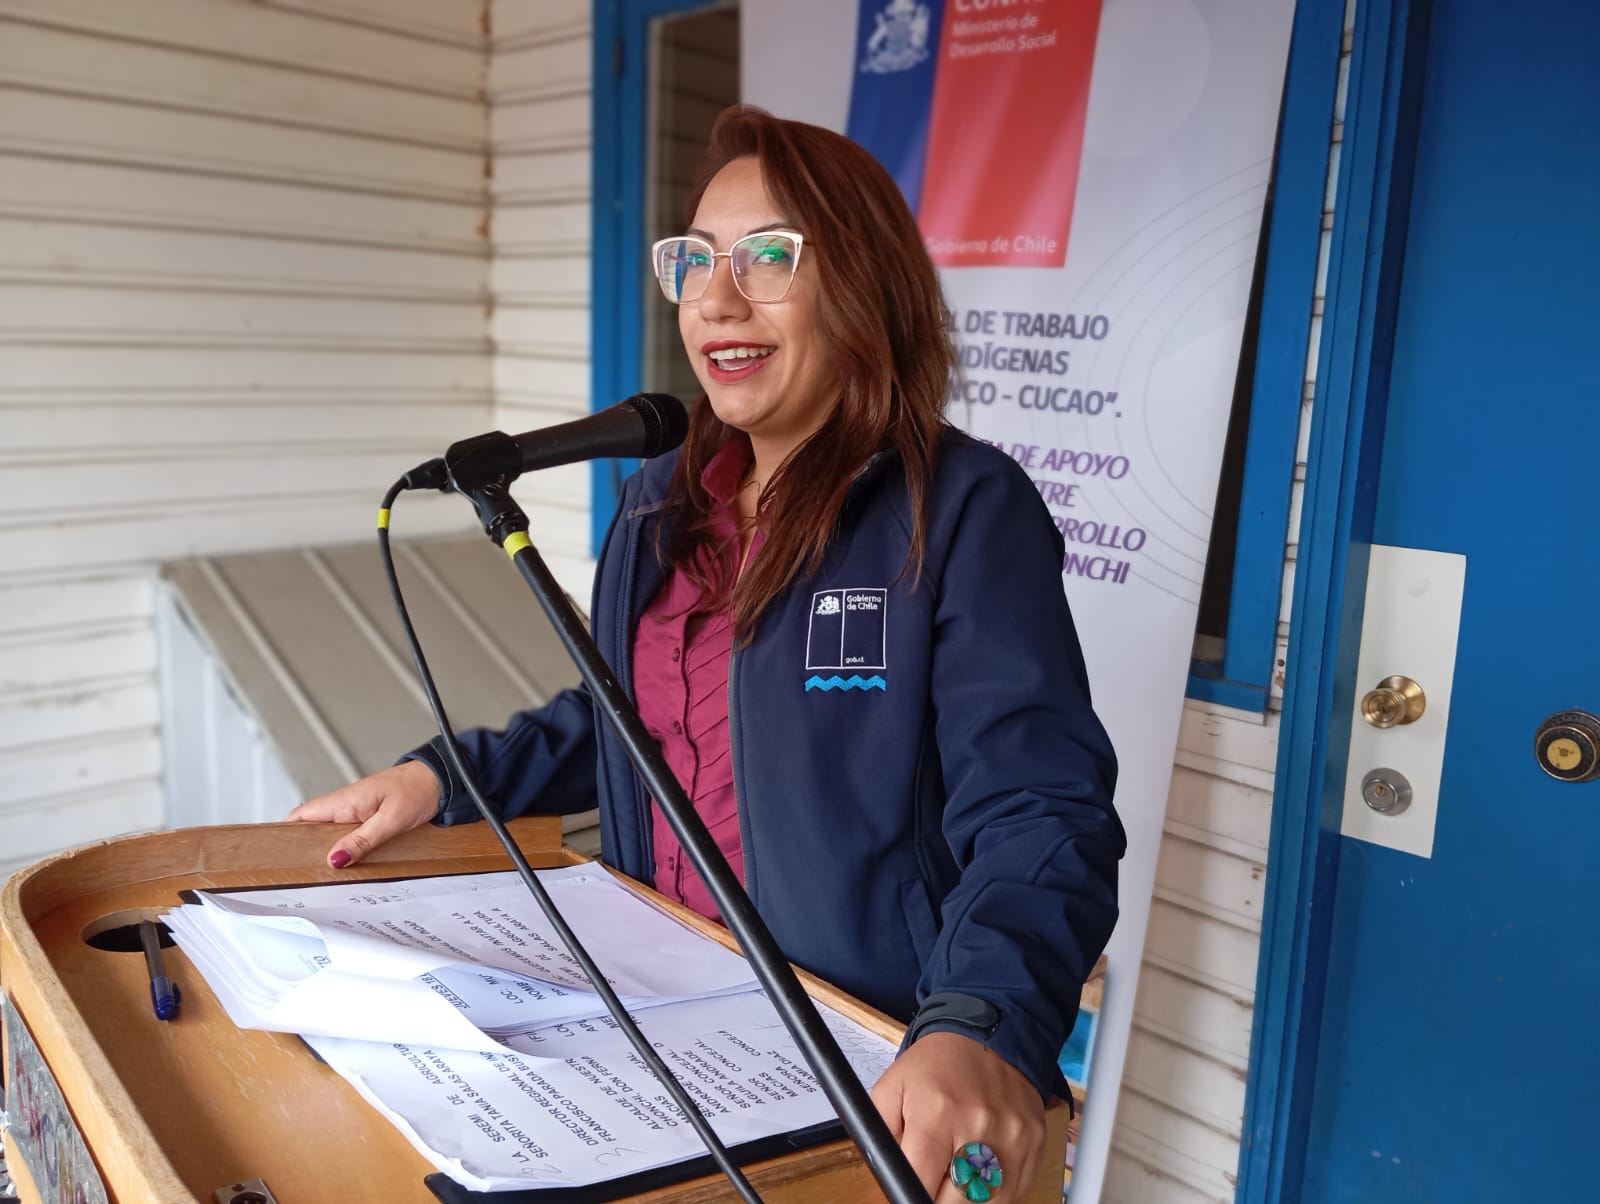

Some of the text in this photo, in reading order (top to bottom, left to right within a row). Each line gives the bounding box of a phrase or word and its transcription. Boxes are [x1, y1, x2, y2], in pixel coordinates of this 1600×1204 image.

[1020, 13, 1038, 29] de
[950, 28, 1057, 58] Desarrollo Social
[991, 238, 1008, 251] de
[1013, 234, 1057, 253] Chile
[965, 310, 997, 334] DE
[1003, 311, 1109, 341] TRABAJO
[1040, 449, 1130, 479] APOYO
[846, 594, 882, 603] Gobierno
[846, 602, 878, 610] de Chile
[429, 983, 467, 1008] JUEVES
[492, 1060, 510, 1072] DE
[681, 1048, 729, 1079] ANDRADE
[506, 1071, 552, 1107] REGIONAL
[525, 1069, 564, 1098] PARADA
[599, 1083, 618, 1096] DE
[607, 1074, 633, 1092] DON
[746, 1076, 785, 1101] SEÑOR
[757, 1071, 798, 1097] MACIAS
[774, 1064, 817, 1093] SEÑORA
[422, 1048, 549, 1157] SEÑORITA TANIA SALAS ARAYA
[445, 1092, 464, 1104] DE
[630, 1091, 678, 1127] CHONCHI,
[680, 1079, 730, 1113] ANDRADE
[713, 1083, 751, 1109] SEÑOR
[547, 1106, 599, 1145] DIRECTOR
[559, 1097, 616, 1141] FRANCISCO
[614, 1095, 663, 1129] ALCALDE
[467, 1112, 505, 1142] SEREMI
[511, 1150, 530, 1162] LA
